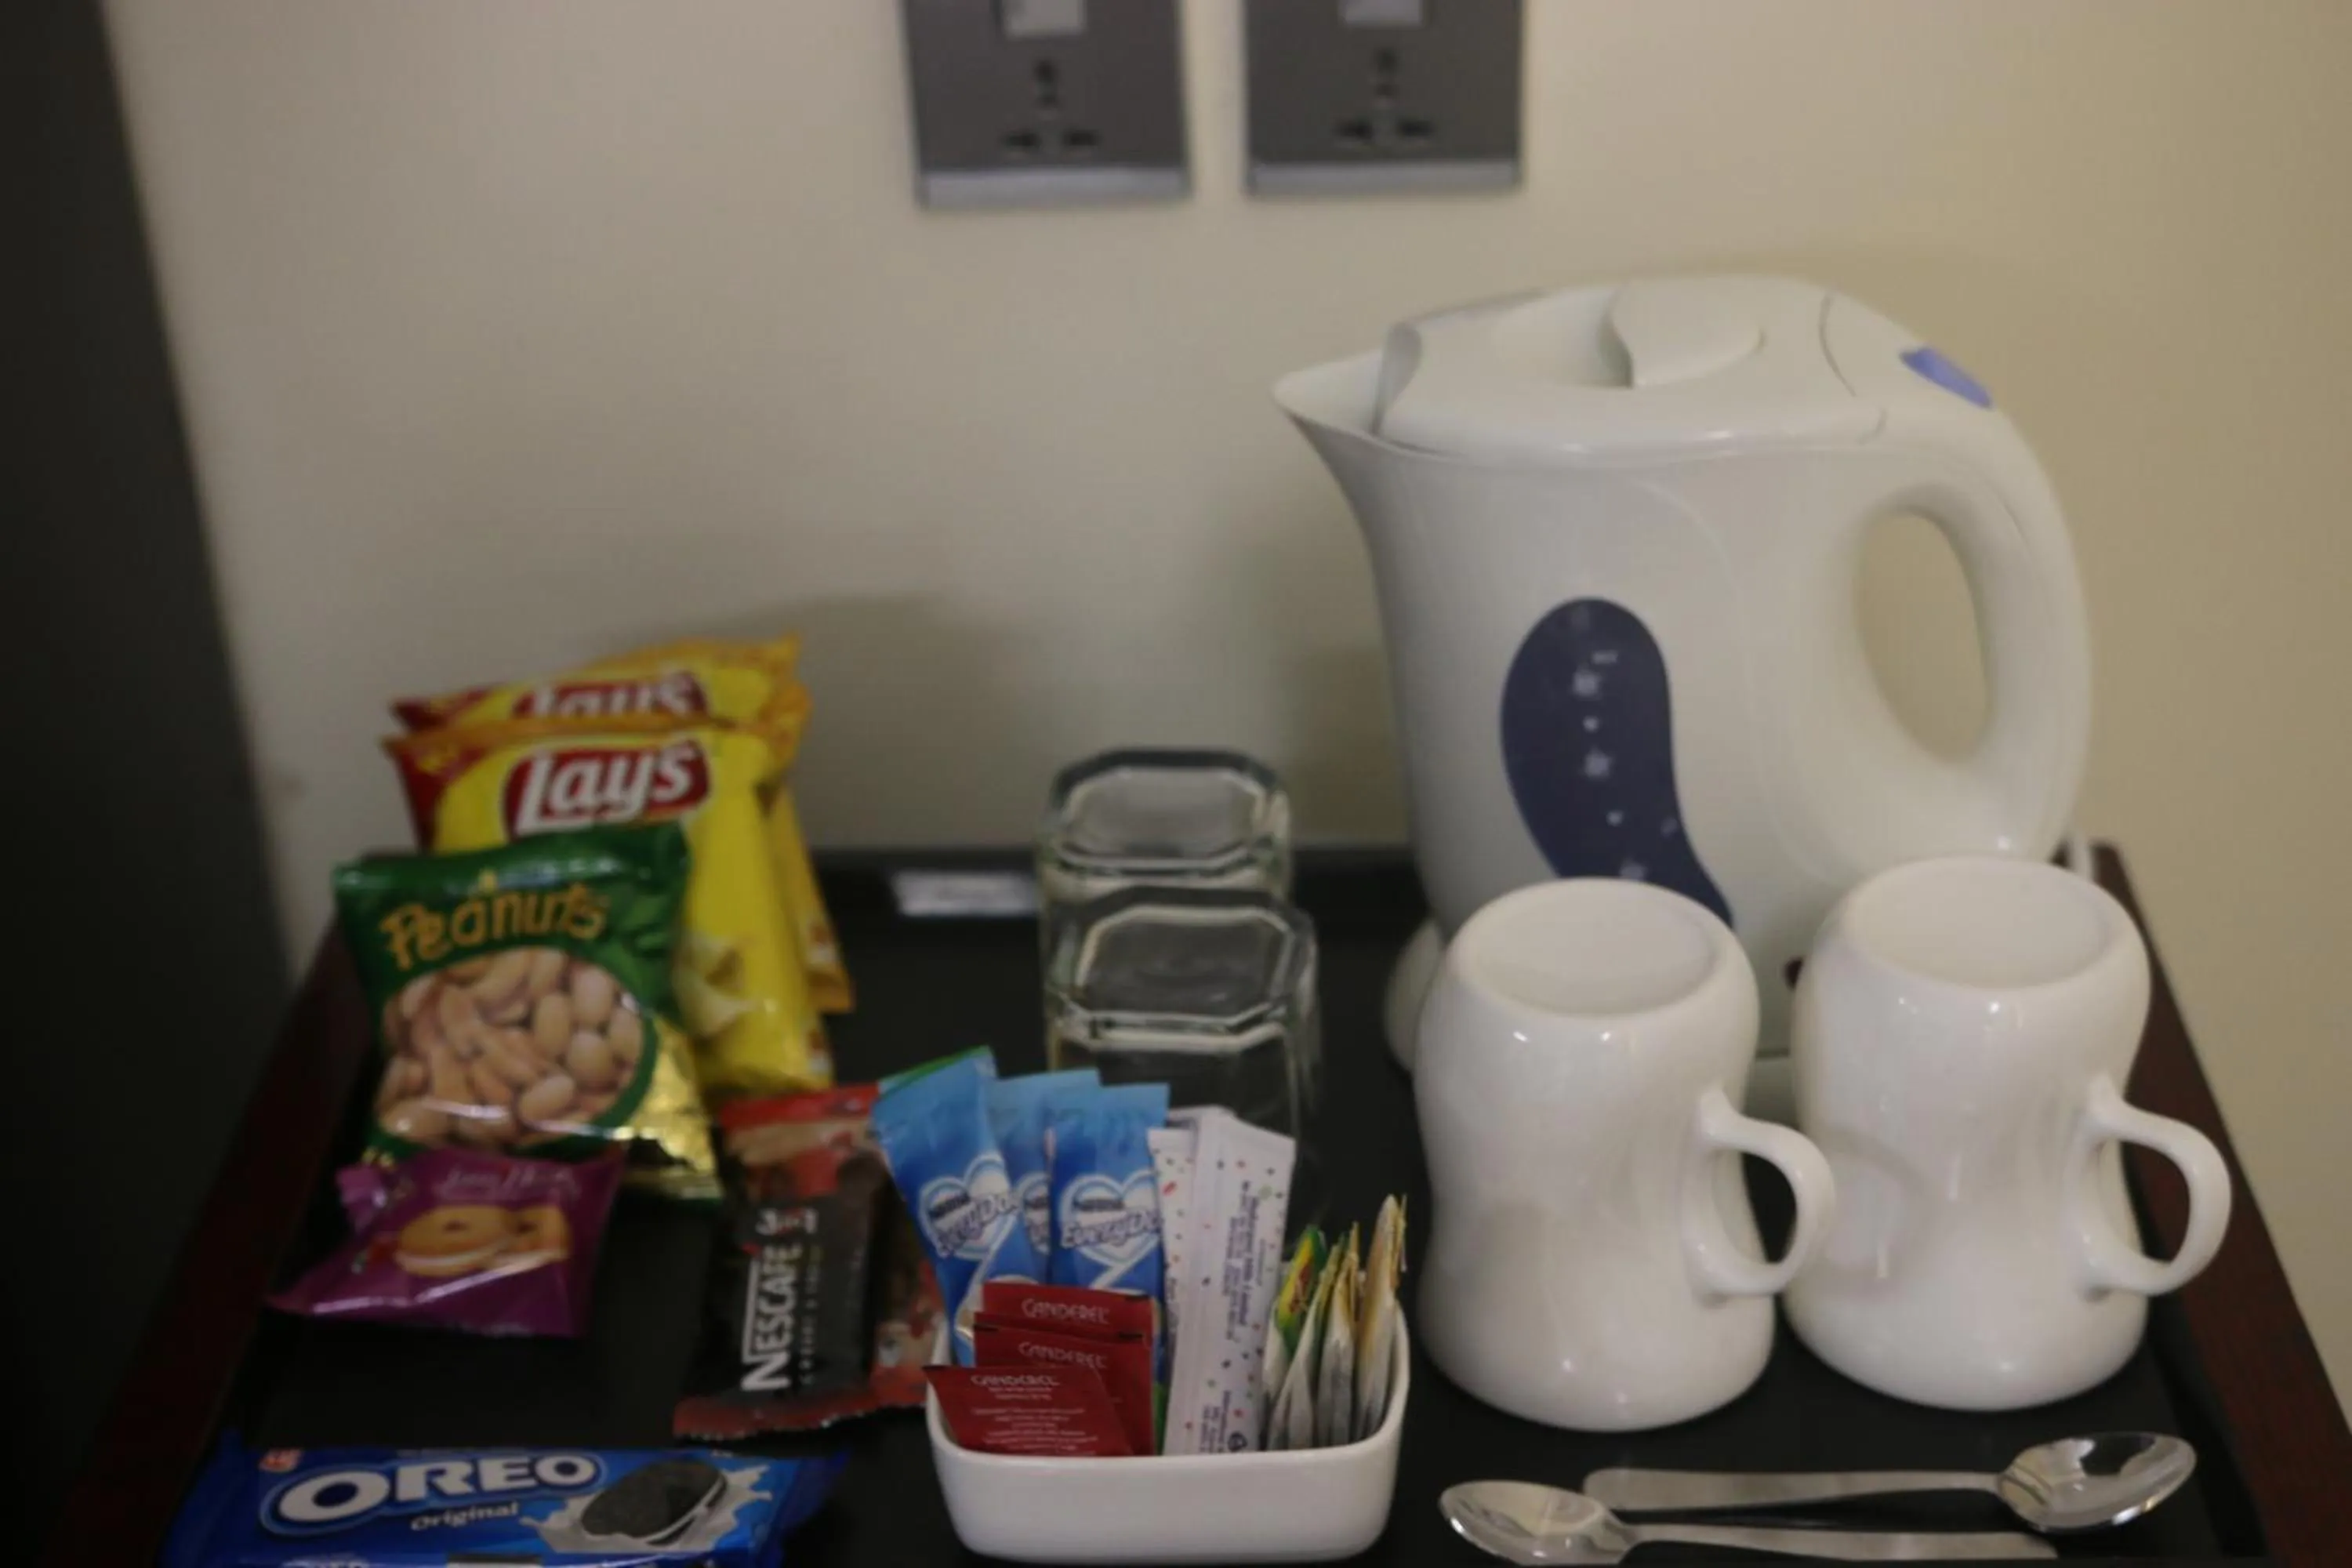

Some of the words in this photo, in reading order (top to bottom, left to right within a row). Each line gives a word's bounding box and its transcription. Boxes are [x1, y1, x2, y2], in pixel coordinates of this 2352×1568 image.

[378, 883, 608, 971] Peanuts
[1021, 1298, 1110, 1324] CANDEREL
[1018, 1341, 1107, 1369] CANDEREL
[274, 1454, 597, 1523] OREO
[411, 1501, 520, 1531] Original
